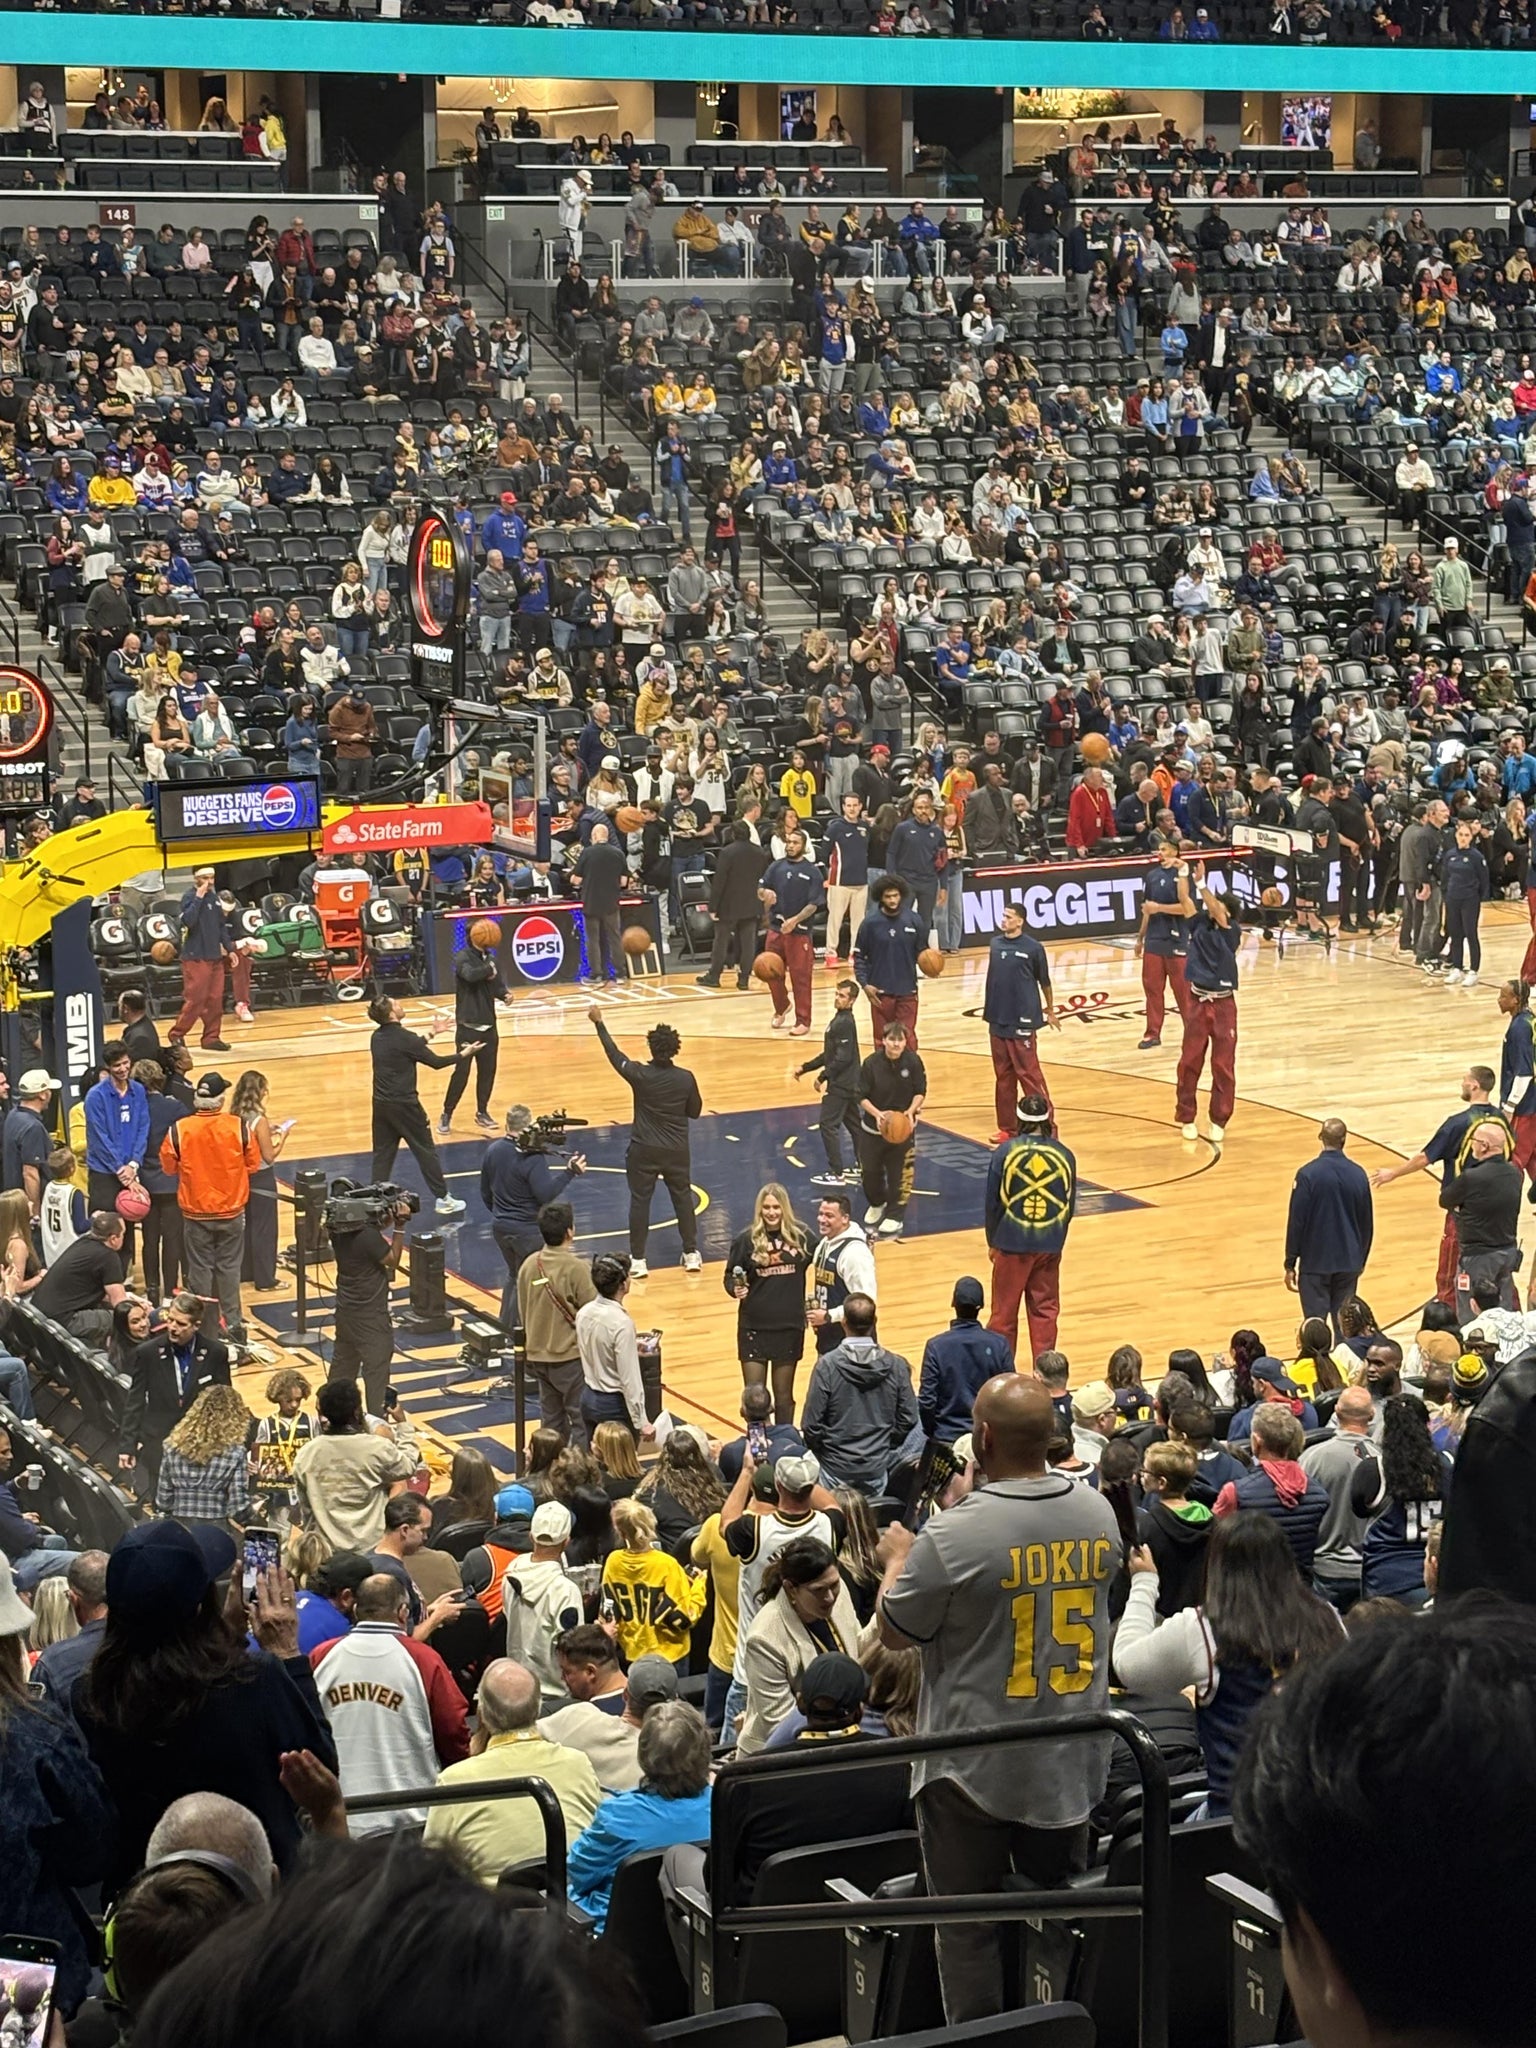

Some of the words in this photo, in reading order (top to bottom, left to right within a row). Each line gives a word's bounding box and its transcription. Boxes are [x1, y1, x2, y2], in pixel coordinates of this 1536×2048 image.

[107, 209, 130, 220] 148
[489, 208, 503, 216] EXIT
[0, 762, 46, 776] ISSOT
[707, 771, 720, 784] 32
[182, 793, 234, 811] NUGGETS
[234, 791, 262, 808] FANS
[264, 801, 294, 812] PEPSI
[183, 807, 264, 827] DESERVE
[358, 821, 401, 843] State
[402, 819, 443, 839] Farm
[408, 868, 420, 880] 27
[338, 885, 354, 902] G
[962, 876, 1143, 934] NUGGET
[369, 899, 395, 923] G
[100, 918, 125, 945] G
[146, 913, 171, 940] G
[515, 940, 560, 957] PEPSI
[47, 1207, 62, 1233] 15
[1000, 1531, 1112, 1589] JOKIĆ
[1006, 1586, 1097, 1698] 15
[327, 1681, 405, 1713] DENVER
[701, 1971, 710, 1996] 8
[855, 1970, 865, 1996] 9
[1033, 1974, 1052, 2006] 10
[1246, 1981, 1265, 2016] 11
